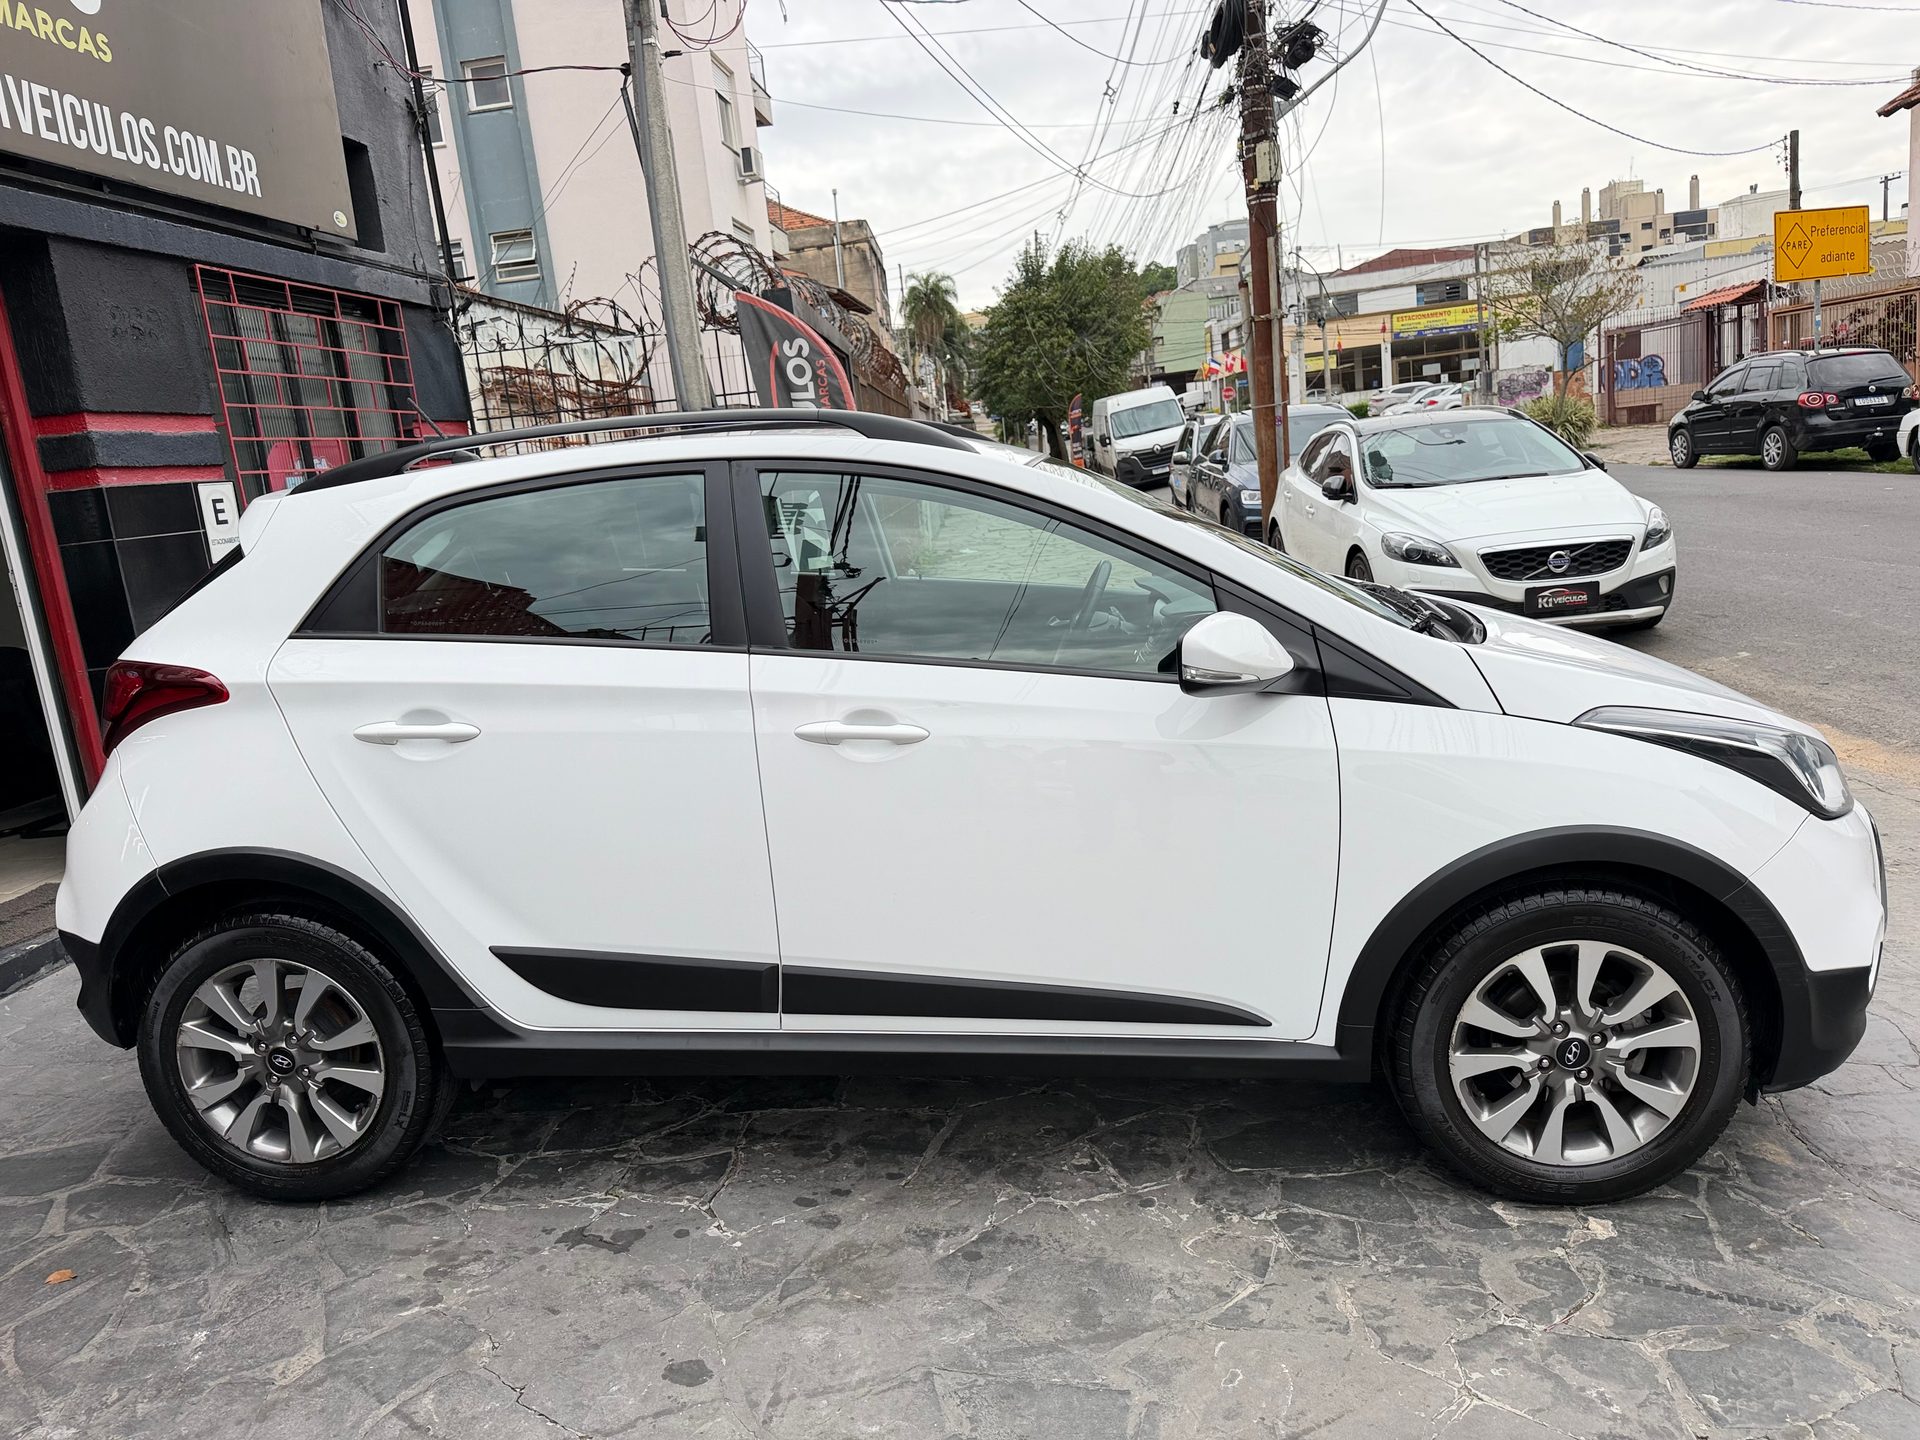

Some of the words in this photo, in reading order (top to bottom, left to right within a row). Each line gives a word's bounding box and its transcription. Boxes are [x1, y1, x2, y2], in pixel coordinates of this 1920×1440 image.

[1810, 222, 1866, 237] Preferencial
[1786, 240, 1808, 250] PARE
[1820, 250, 1856, 263] adiante
[1397, 310, 1451, 322] ESTACIONAMENTO
[211, 498, 228, 525] E
